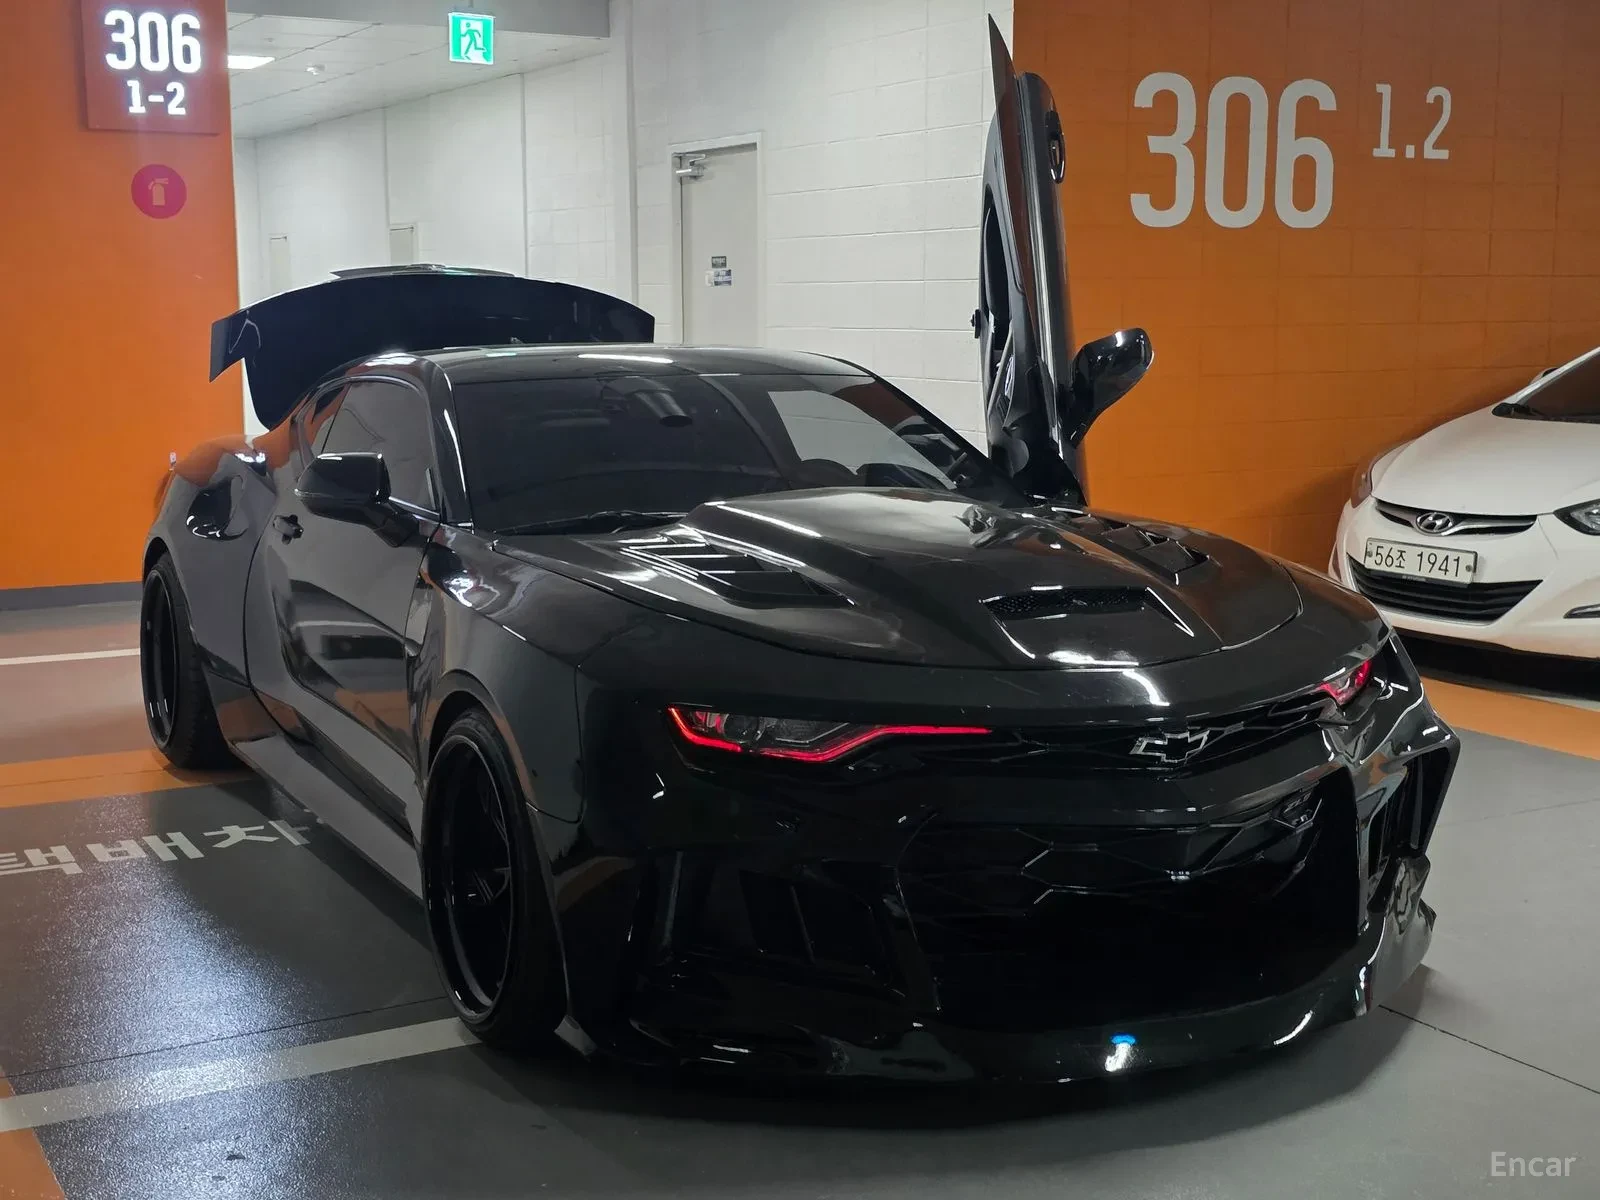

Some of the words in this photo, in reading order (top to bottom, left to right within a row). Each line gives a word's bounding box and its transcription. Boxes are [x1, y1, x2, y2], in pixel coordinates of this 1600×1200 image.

[104, 9, 202, 74] 306
[126, 79, 187, 115] 1-2
[1130, 71, 1337, 229] 306
[1372, 83, 1452, 160] 1.2
[1374, 545, 1407, 569] 56조
[1416, 551, 1461, 578] 1941
